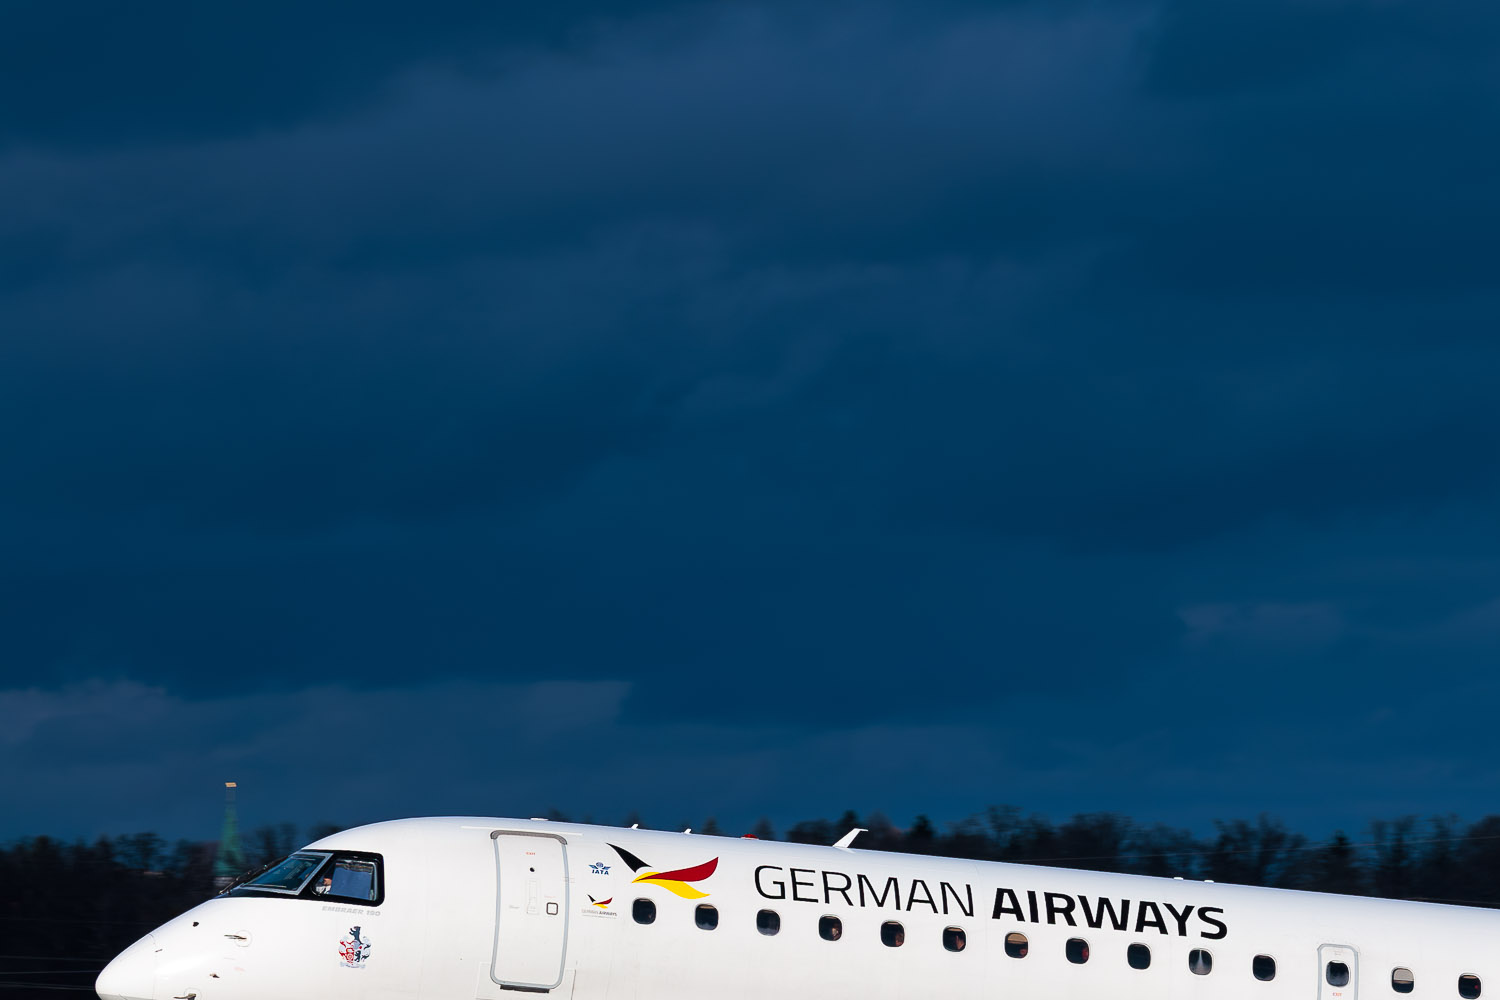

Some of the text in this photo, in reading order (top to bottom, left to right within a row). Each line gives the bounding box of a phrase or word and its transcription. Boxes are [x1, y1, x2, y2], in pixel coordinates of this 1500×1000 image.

[321, 905, 364, 915] EMBRAER
[754, 865, 1228, 940] GERMAN AIRWAYS
